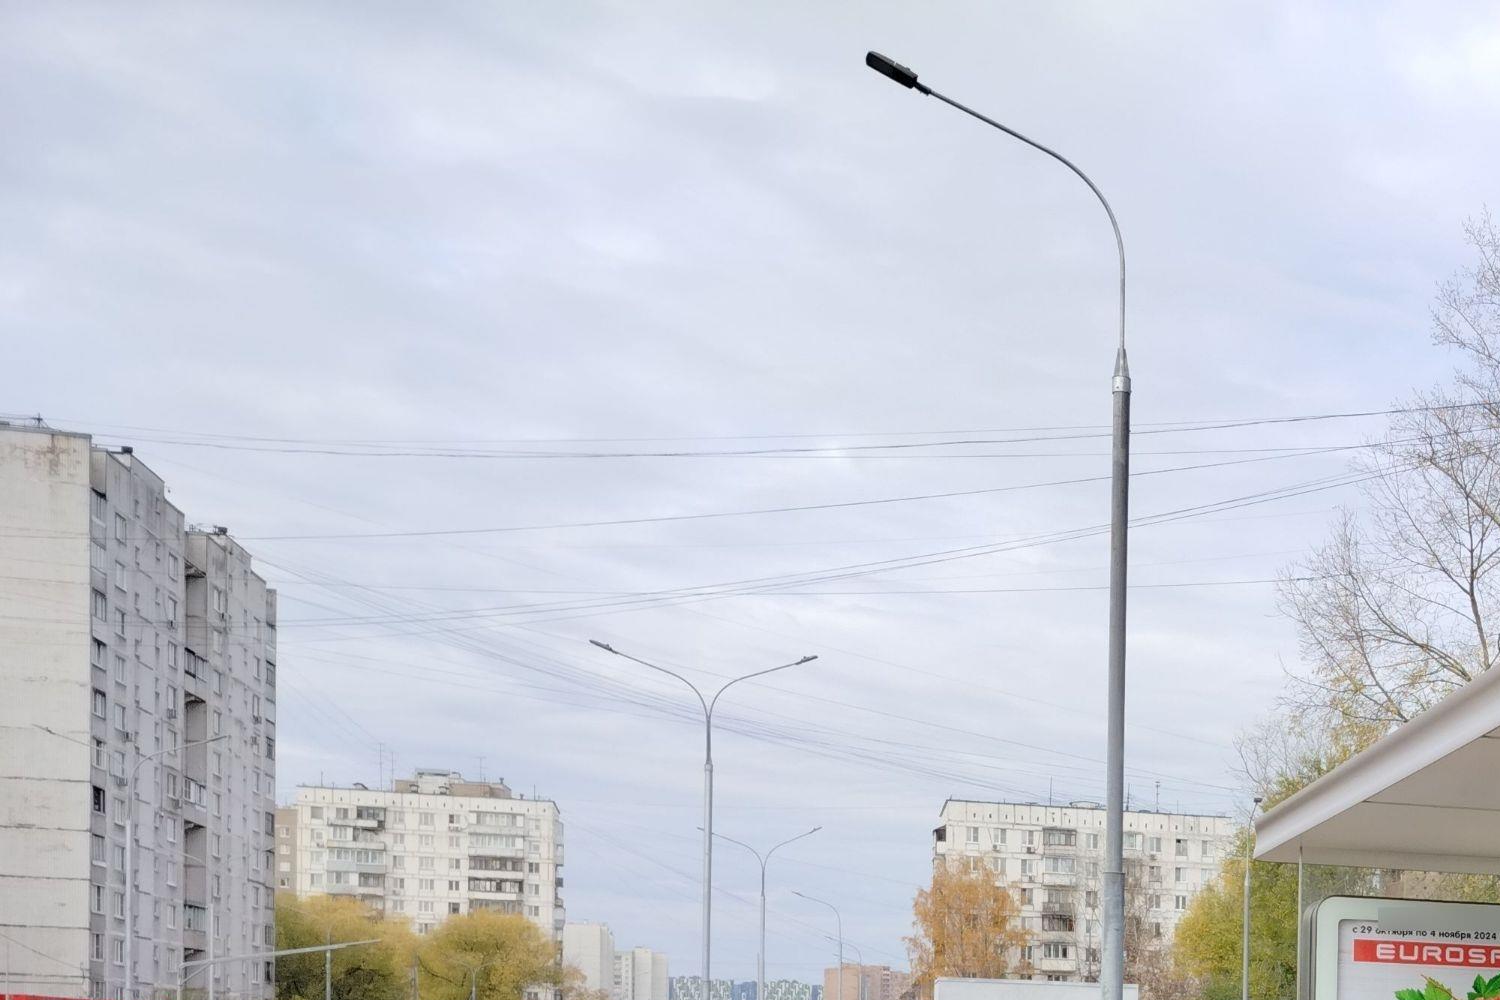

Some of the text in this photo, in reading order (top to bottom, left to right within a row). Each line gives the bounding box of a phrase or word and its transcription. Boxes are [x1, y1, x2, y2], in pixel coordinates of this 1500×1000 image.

[1361, 925, 1372, 935] 29
[1416, 930, 1428, 938] по
[1439, 930, 1471, 940] ноября
[1474, 931, 1497, 940] 2024
